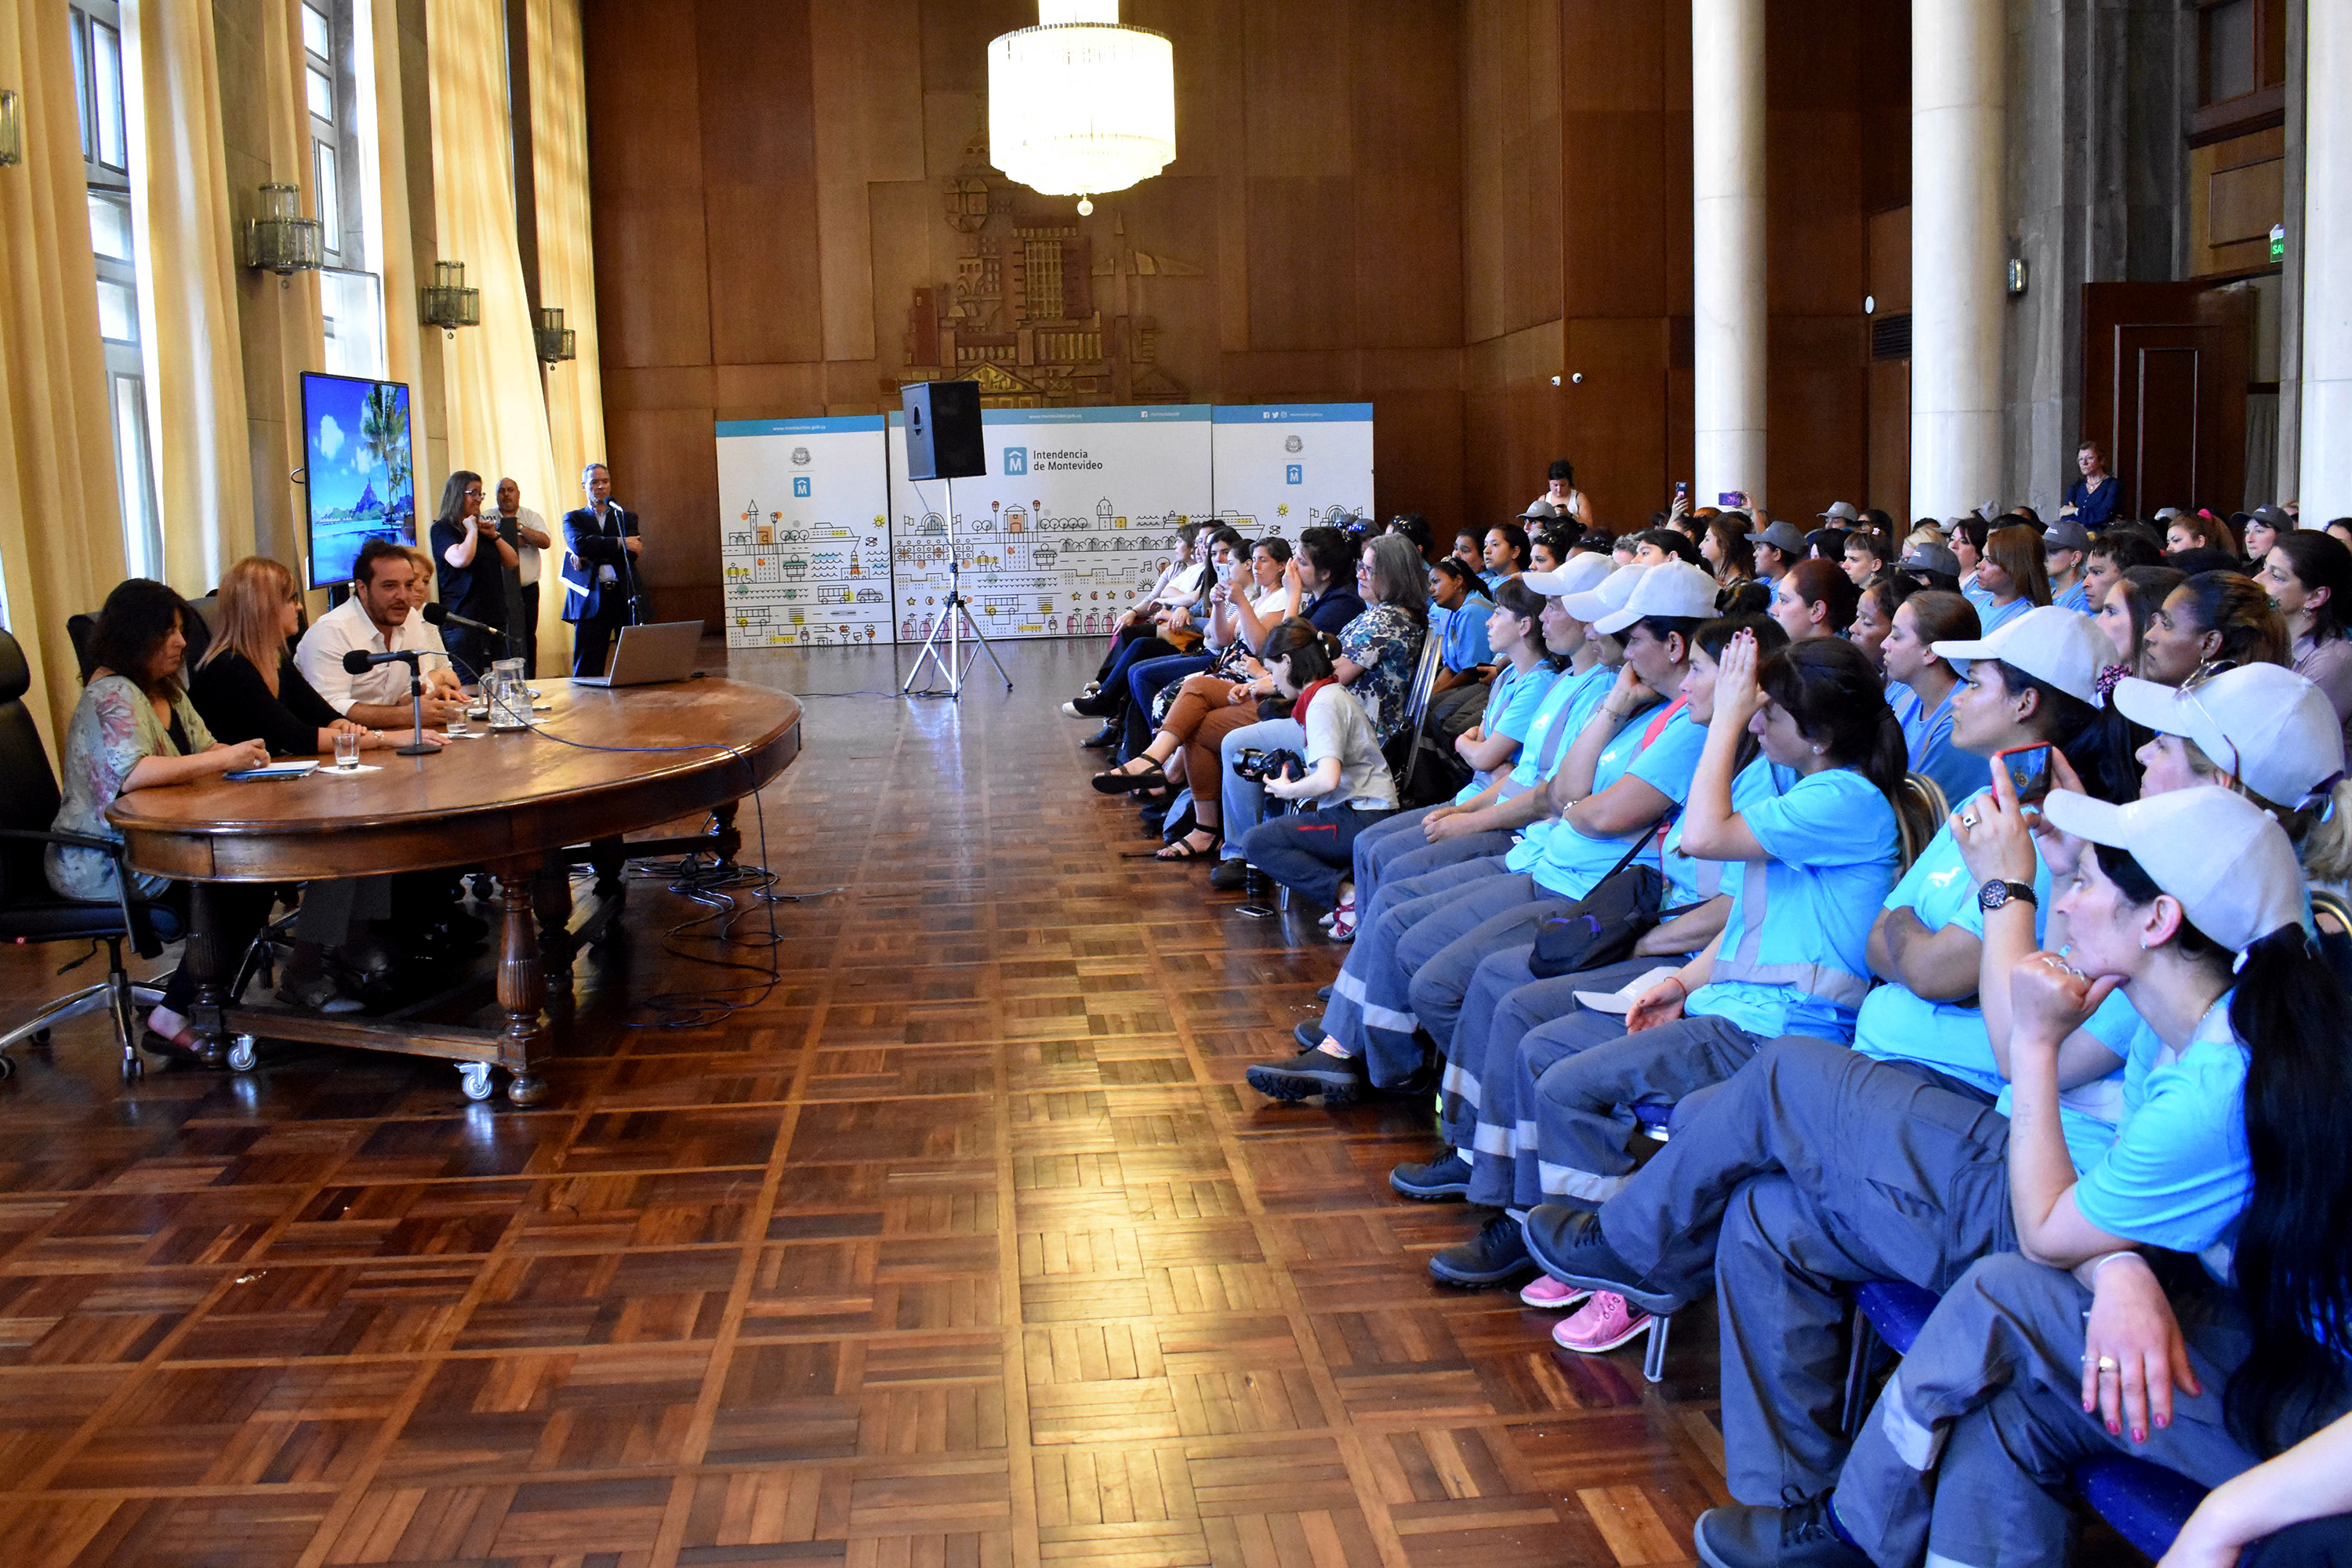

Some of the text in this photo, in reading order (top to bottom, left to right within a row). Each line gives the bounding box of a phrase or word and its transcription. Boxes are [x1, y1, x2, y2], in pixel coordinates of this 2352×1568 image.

[1033, 449, 1088, 459] Intendencia
[1033, 460, 1103, 471] de Montevideo
